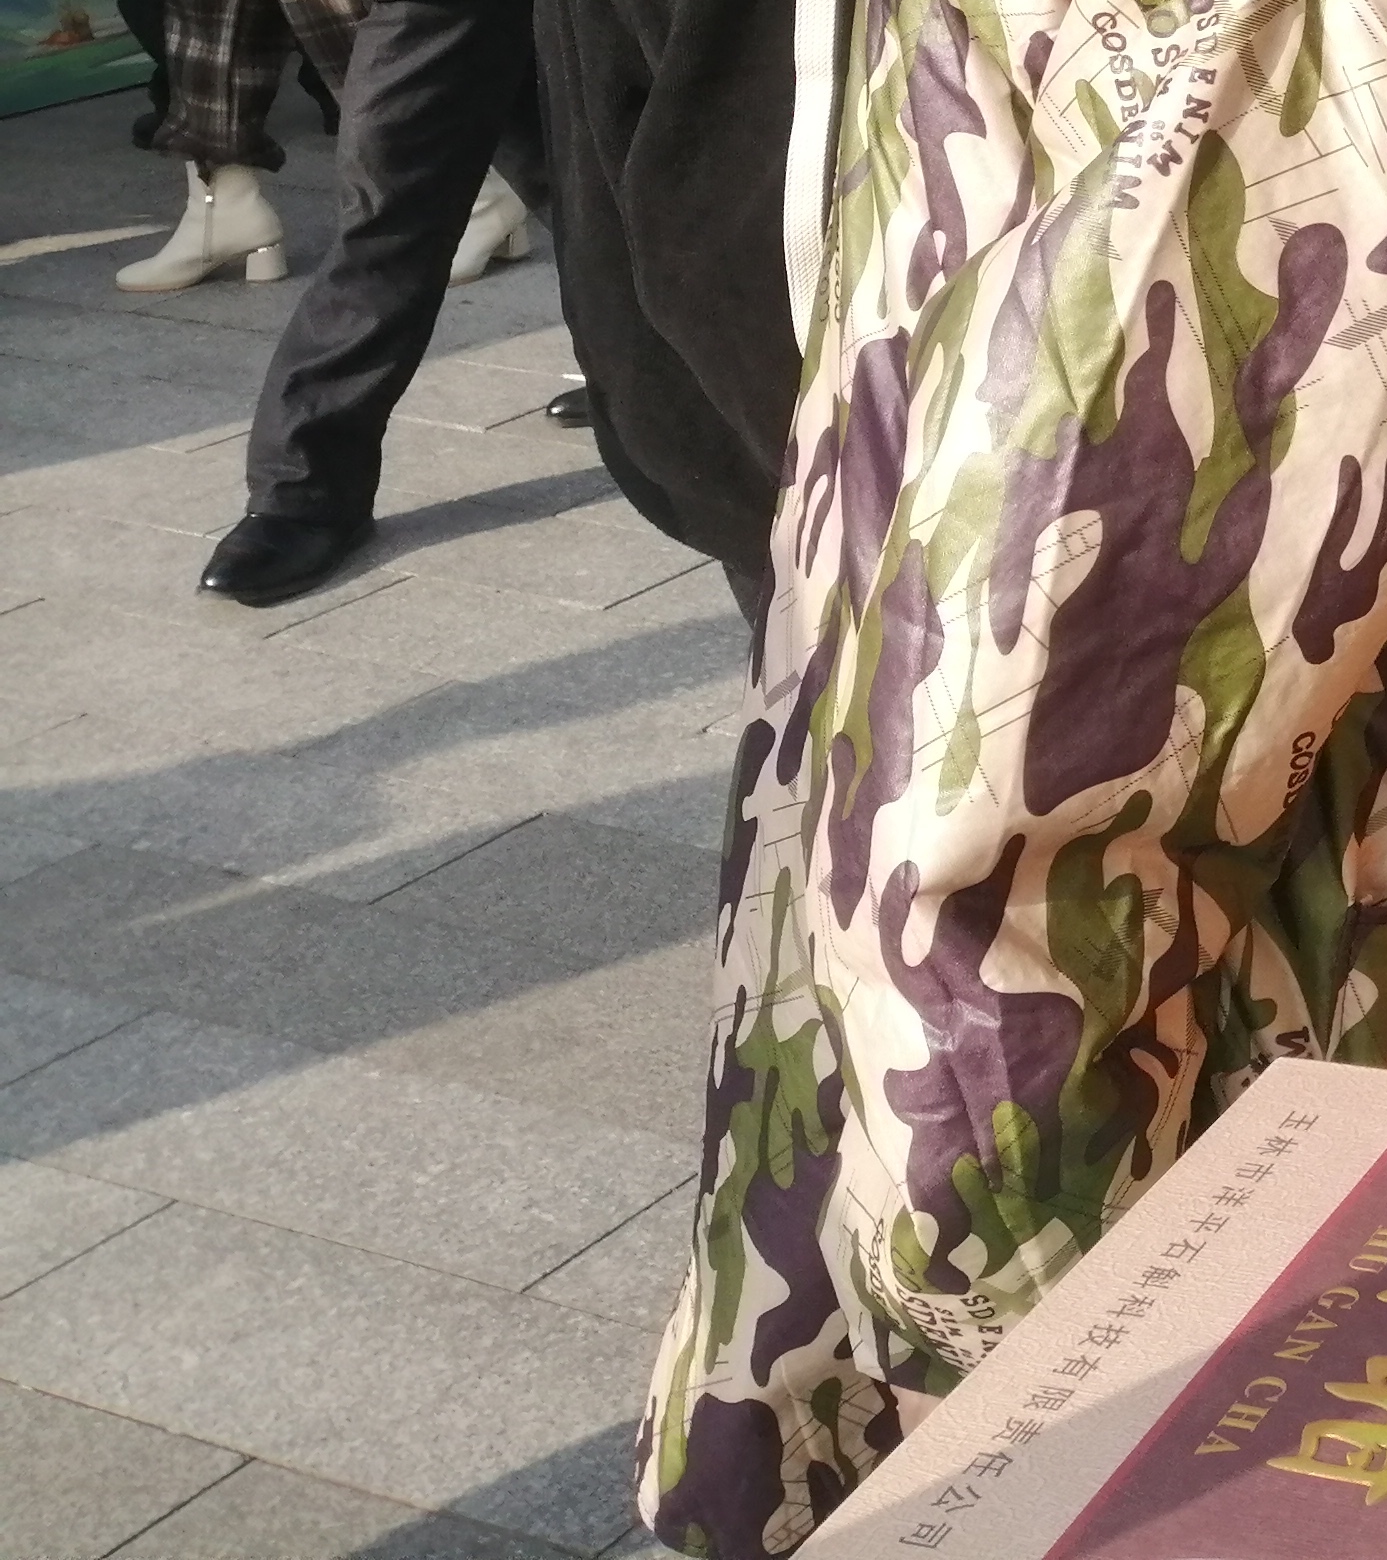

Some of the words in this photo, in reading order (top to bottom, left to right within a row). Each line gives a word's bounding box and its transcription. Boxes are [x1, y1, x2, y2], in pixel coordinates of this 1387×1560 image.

[900, 1109, 1320, 1550] 玉林市洋平石斛科技有限责任公司
[1272, 1286, 1360, 1365] GAN
[1193, 1376, 1288, 1456] CHA
